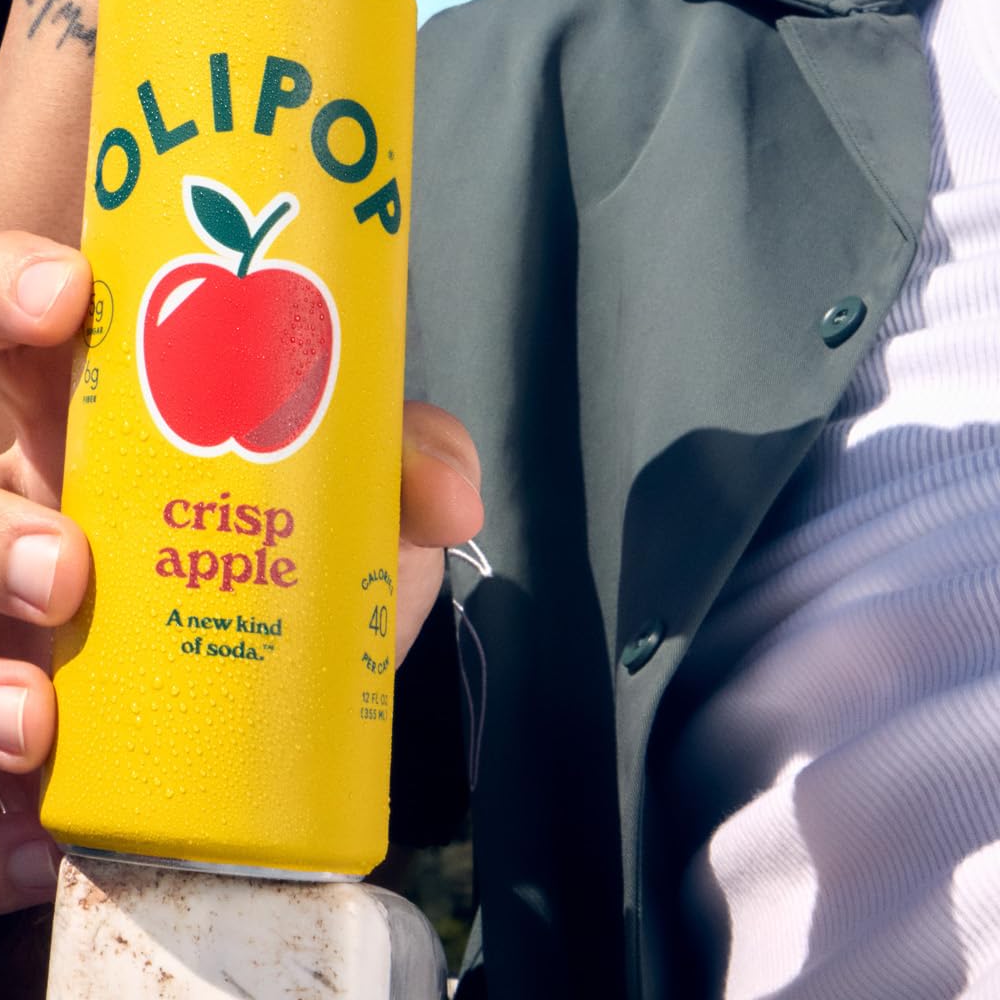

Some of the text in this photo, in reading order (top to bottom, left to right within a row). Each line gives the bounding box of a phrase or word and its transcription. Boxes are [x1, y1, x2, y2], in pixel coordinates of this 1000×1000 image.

[95, 52, 401, 236] OLIPOP
[162, 492, 296, 547] crisp
[155, 545, 299, 592] apple
[165, 608, 282, 636] A new kind
[368, 604, 388, 638] 40
[181, 636, 203, 654] of
[361, 652, 377, 673] PER
[362, 691, 370, 704] 12
[371, 692, 379, 705] FL
